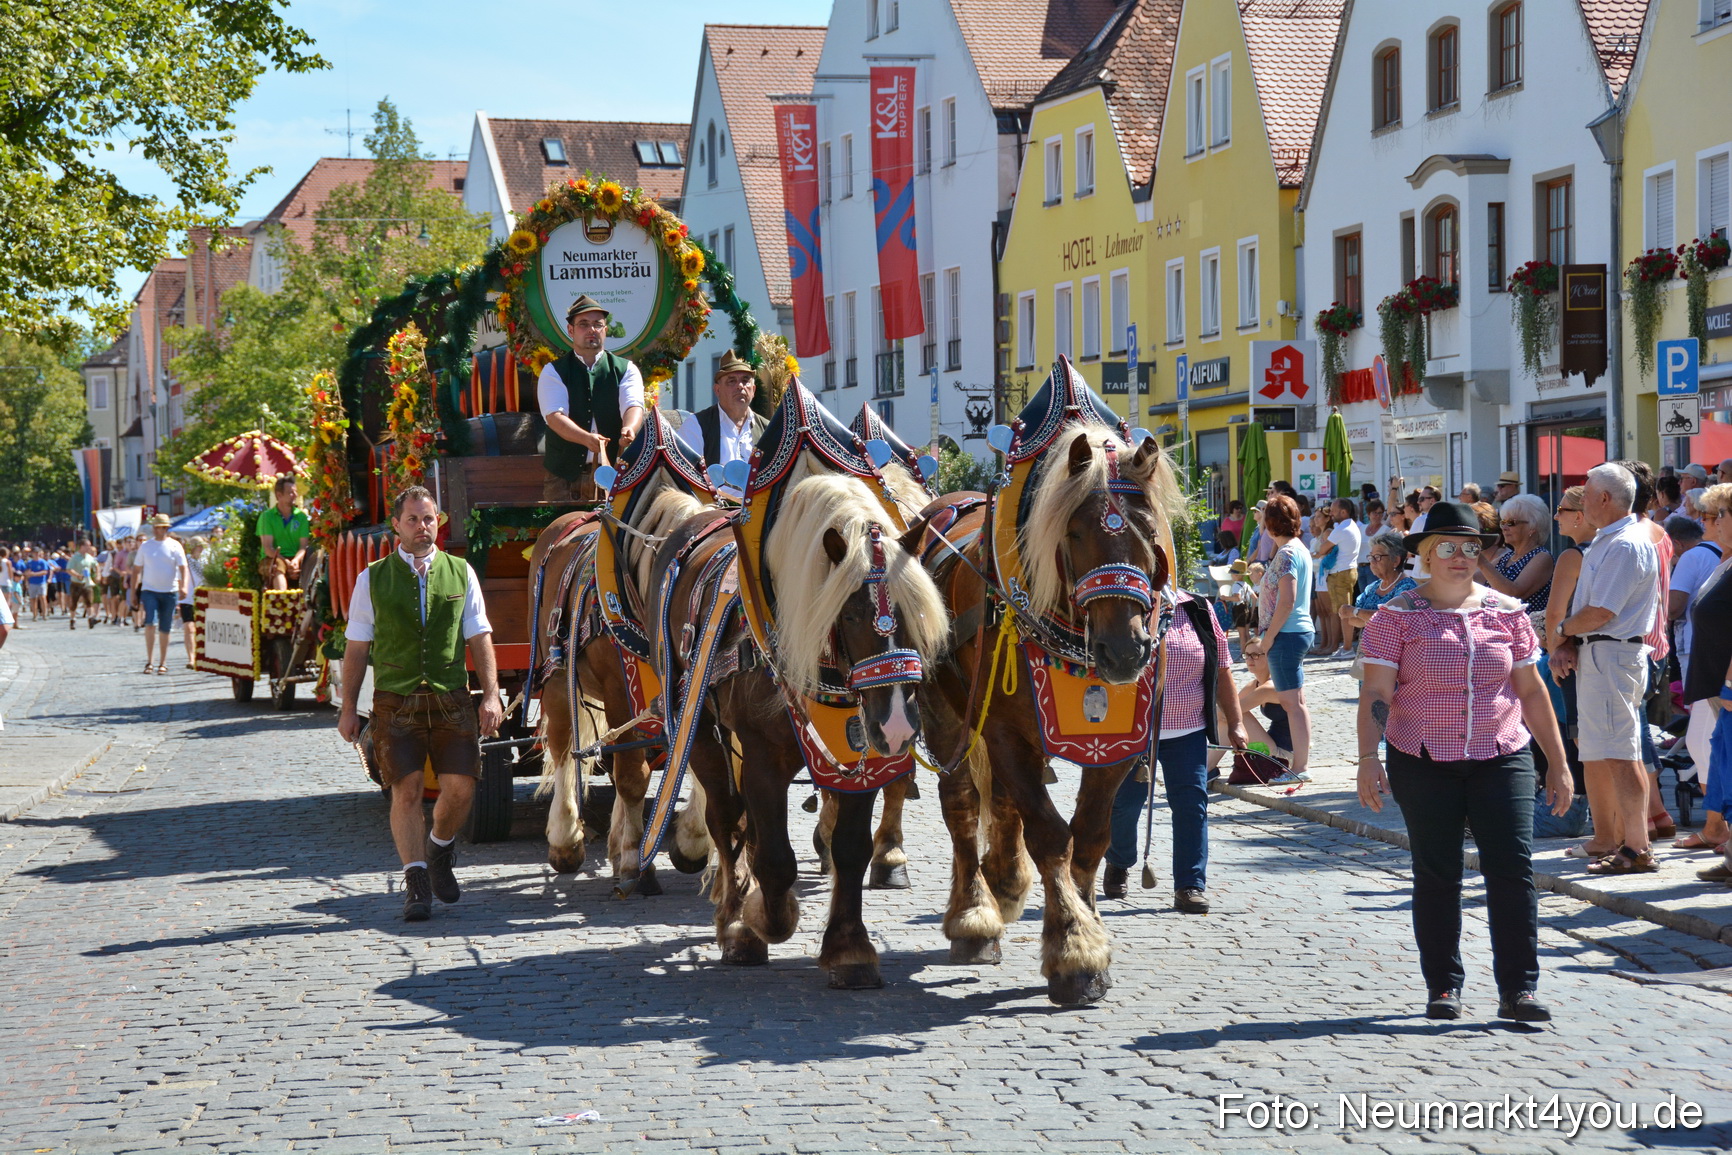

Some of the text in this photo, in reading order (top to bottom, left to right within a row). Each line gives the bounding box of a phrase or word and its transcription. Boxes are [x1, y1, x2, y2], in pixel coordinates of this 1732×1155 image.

[876, 75, 898, 138] K&L
[899, 76, 907, 138] RUPPERT
[563, 249, 637, 262] Neumarkter
[1063, 228, 1143, 272] HOTEL Lehmeier
[549, 262, 651, 280] Lammsbräu
[1706, 312, 1731, 330] WOLLE
[1178, 361, 1185, 395] P
[1188, 362, 1220, 386] TAIFUN
[1667, 346, 1689, 389] P
[1105, 382, 1147, 390] TAIFN
[1671, 402, 1684, 410] nur
[1415, 419, 1438, 431] APOTHEKE
